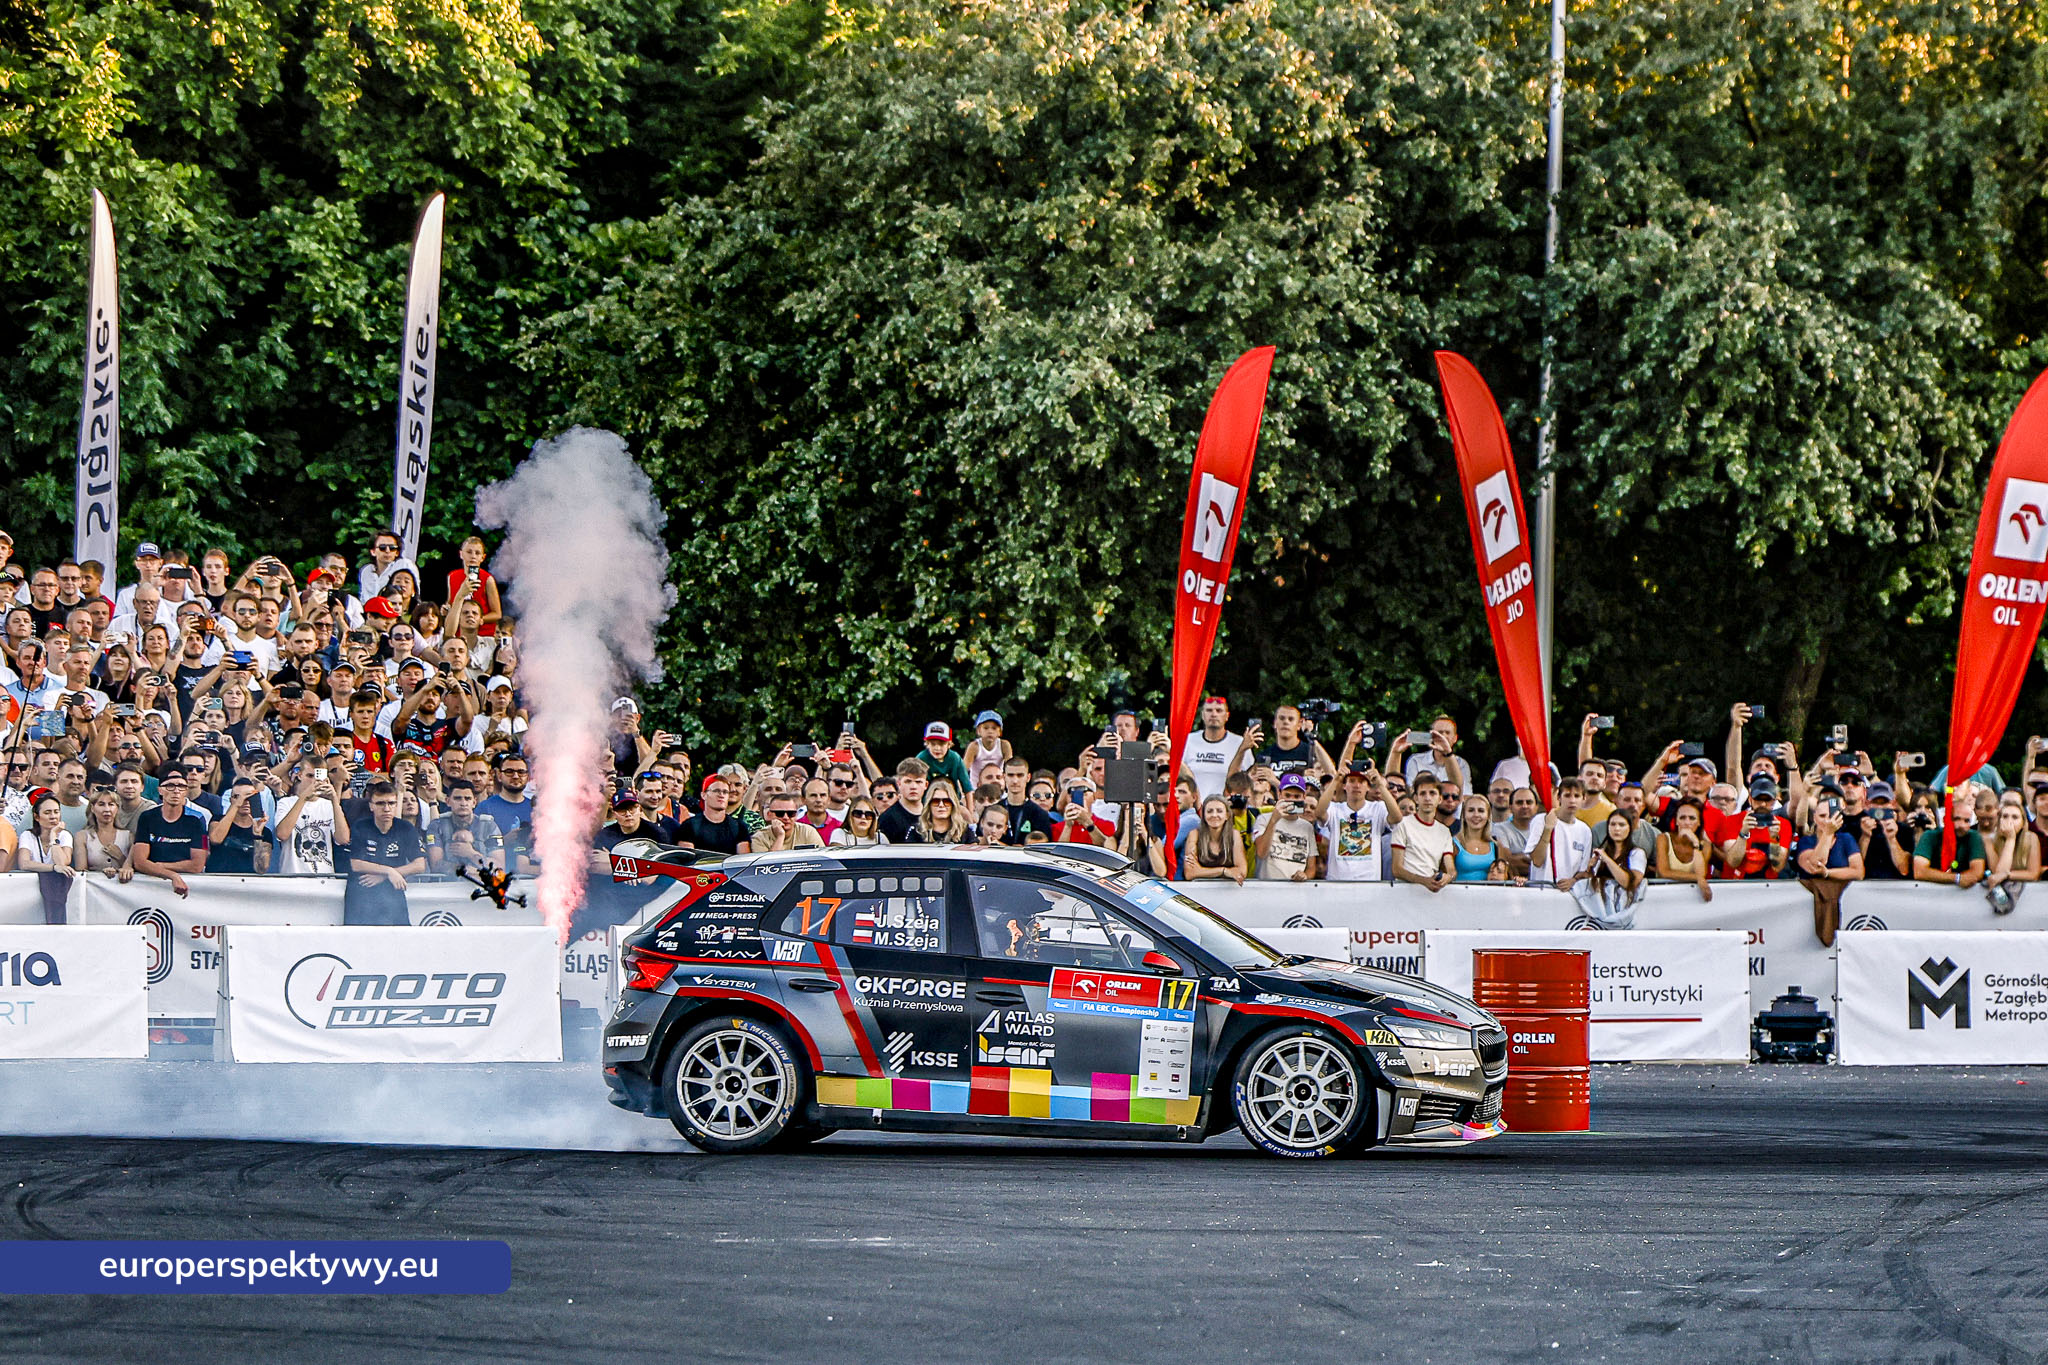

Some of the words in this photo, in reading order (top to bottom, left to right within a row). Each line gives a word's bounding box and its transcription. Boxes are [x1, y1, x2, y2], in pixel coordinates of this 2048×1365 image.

[1979, 573, 2048, 604] ORLEN
[1993, 606, 2020, 626] OIL
[725, 894, 767, 902] STASIAK
[705, 912, 758, 920] MEGA-PRESS
[796, 896, 842, 936] 17
[874, 932, 939, 951] M.Szeja
[565, 949, 609, 980] ŚLĄS
[1350, 956, 1419, 975] TADION
[1592, 963, 1663, 978] terstwo
[336, 973, 507, 1000] MOTO
[855, 976, 967, 999] GKFORGE
[1105, 980, 1142, 990] ORLEN
[1105, 989, 1119, 997] OIL
[1167, 980, 1194, 1010] 17
[1610, 986, 1614, 1002] i
[1619, 985, 1703, 1005] Turystyki
[854, 997, 890, 1009] Kuźnia
[892, 999, 964, 1013] Przemysłowa
[1083, 1003, 1095, 1011] FIA
[1111, 1006, 1159, 1018] Championship
[331, 1008, 490, 1026] WIZJA
[1004, 1010, 1055, 1024] ATLAS
[1985, 1009, 2048, 1024] Metropo
[1005, 1023, 1054, 1037] WARD
[1512, 1032, 1555, 1044] ORLEN
[749, 1024, 790, 1060] MICHELIN
[1512, 1045, 1529, 1054] OIL
[911, 1050, 958, 1068] KSSE
[1387, 1058, 1407, 1066] KSSE
